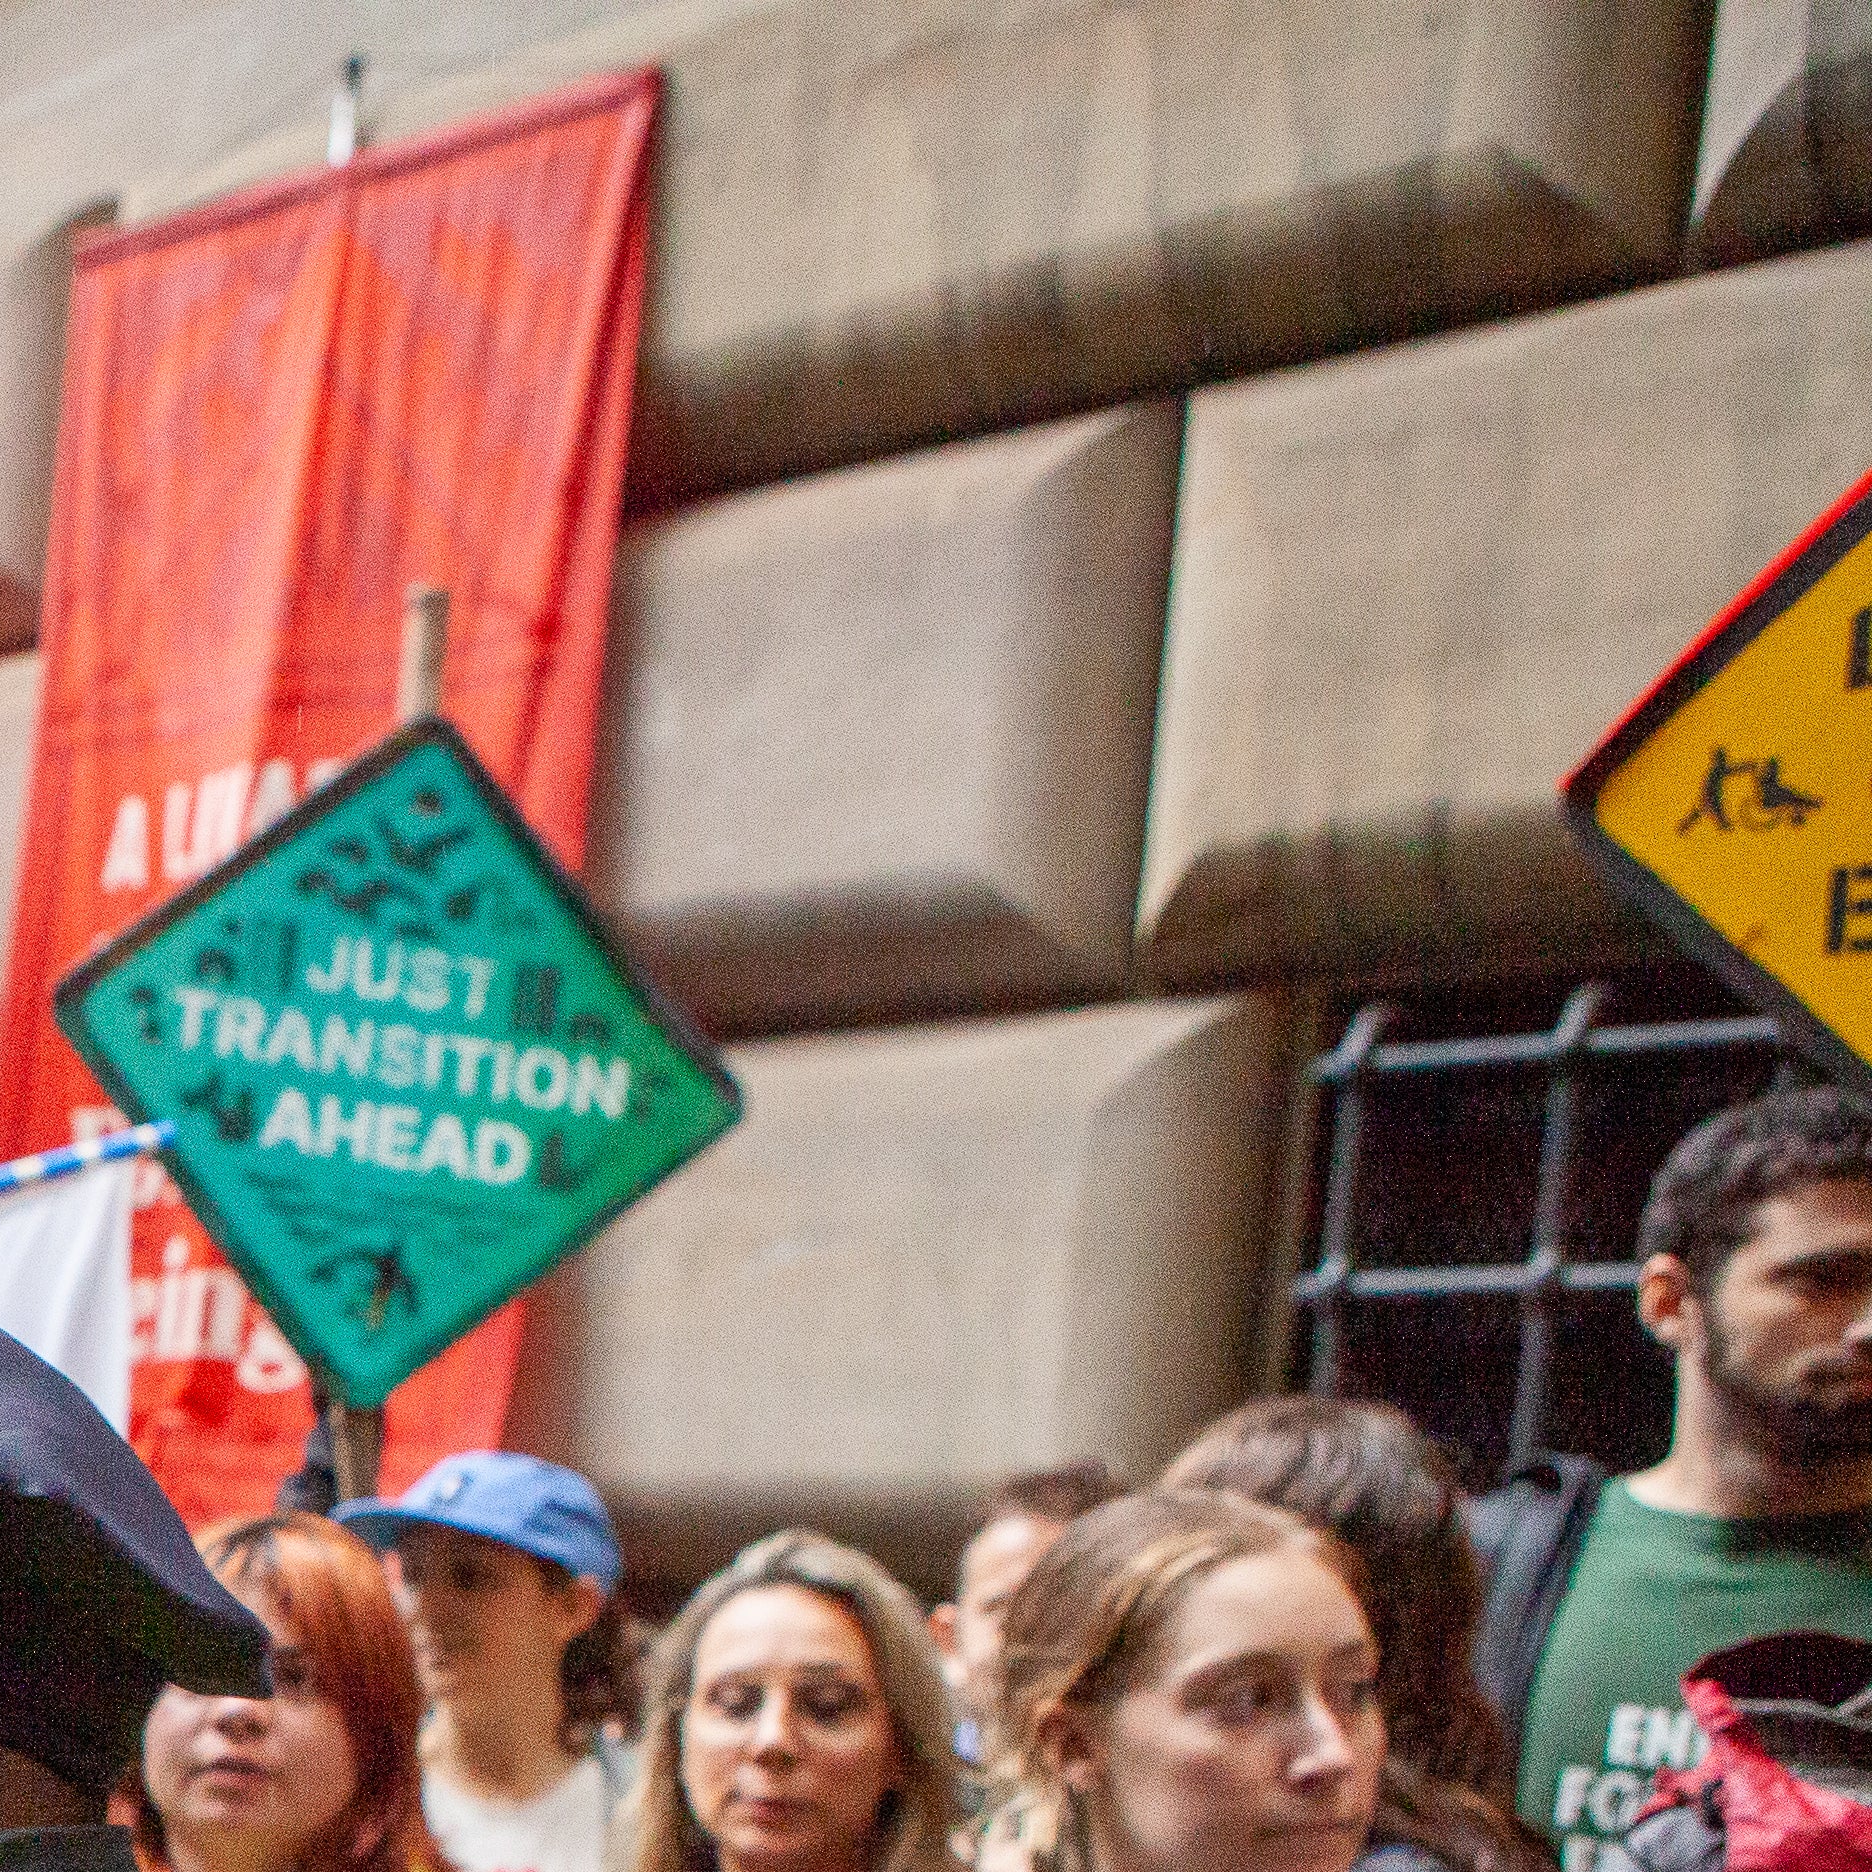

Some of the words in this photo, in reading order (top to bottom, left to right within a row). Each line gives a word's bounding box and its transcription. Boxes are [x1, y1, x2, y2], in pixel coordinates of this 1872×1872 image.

[306, 936, 496, 1021] JUST
[174, 987, 632, 1121] TRANSITION
[259, 1087, 533, 1186] AHEAD
